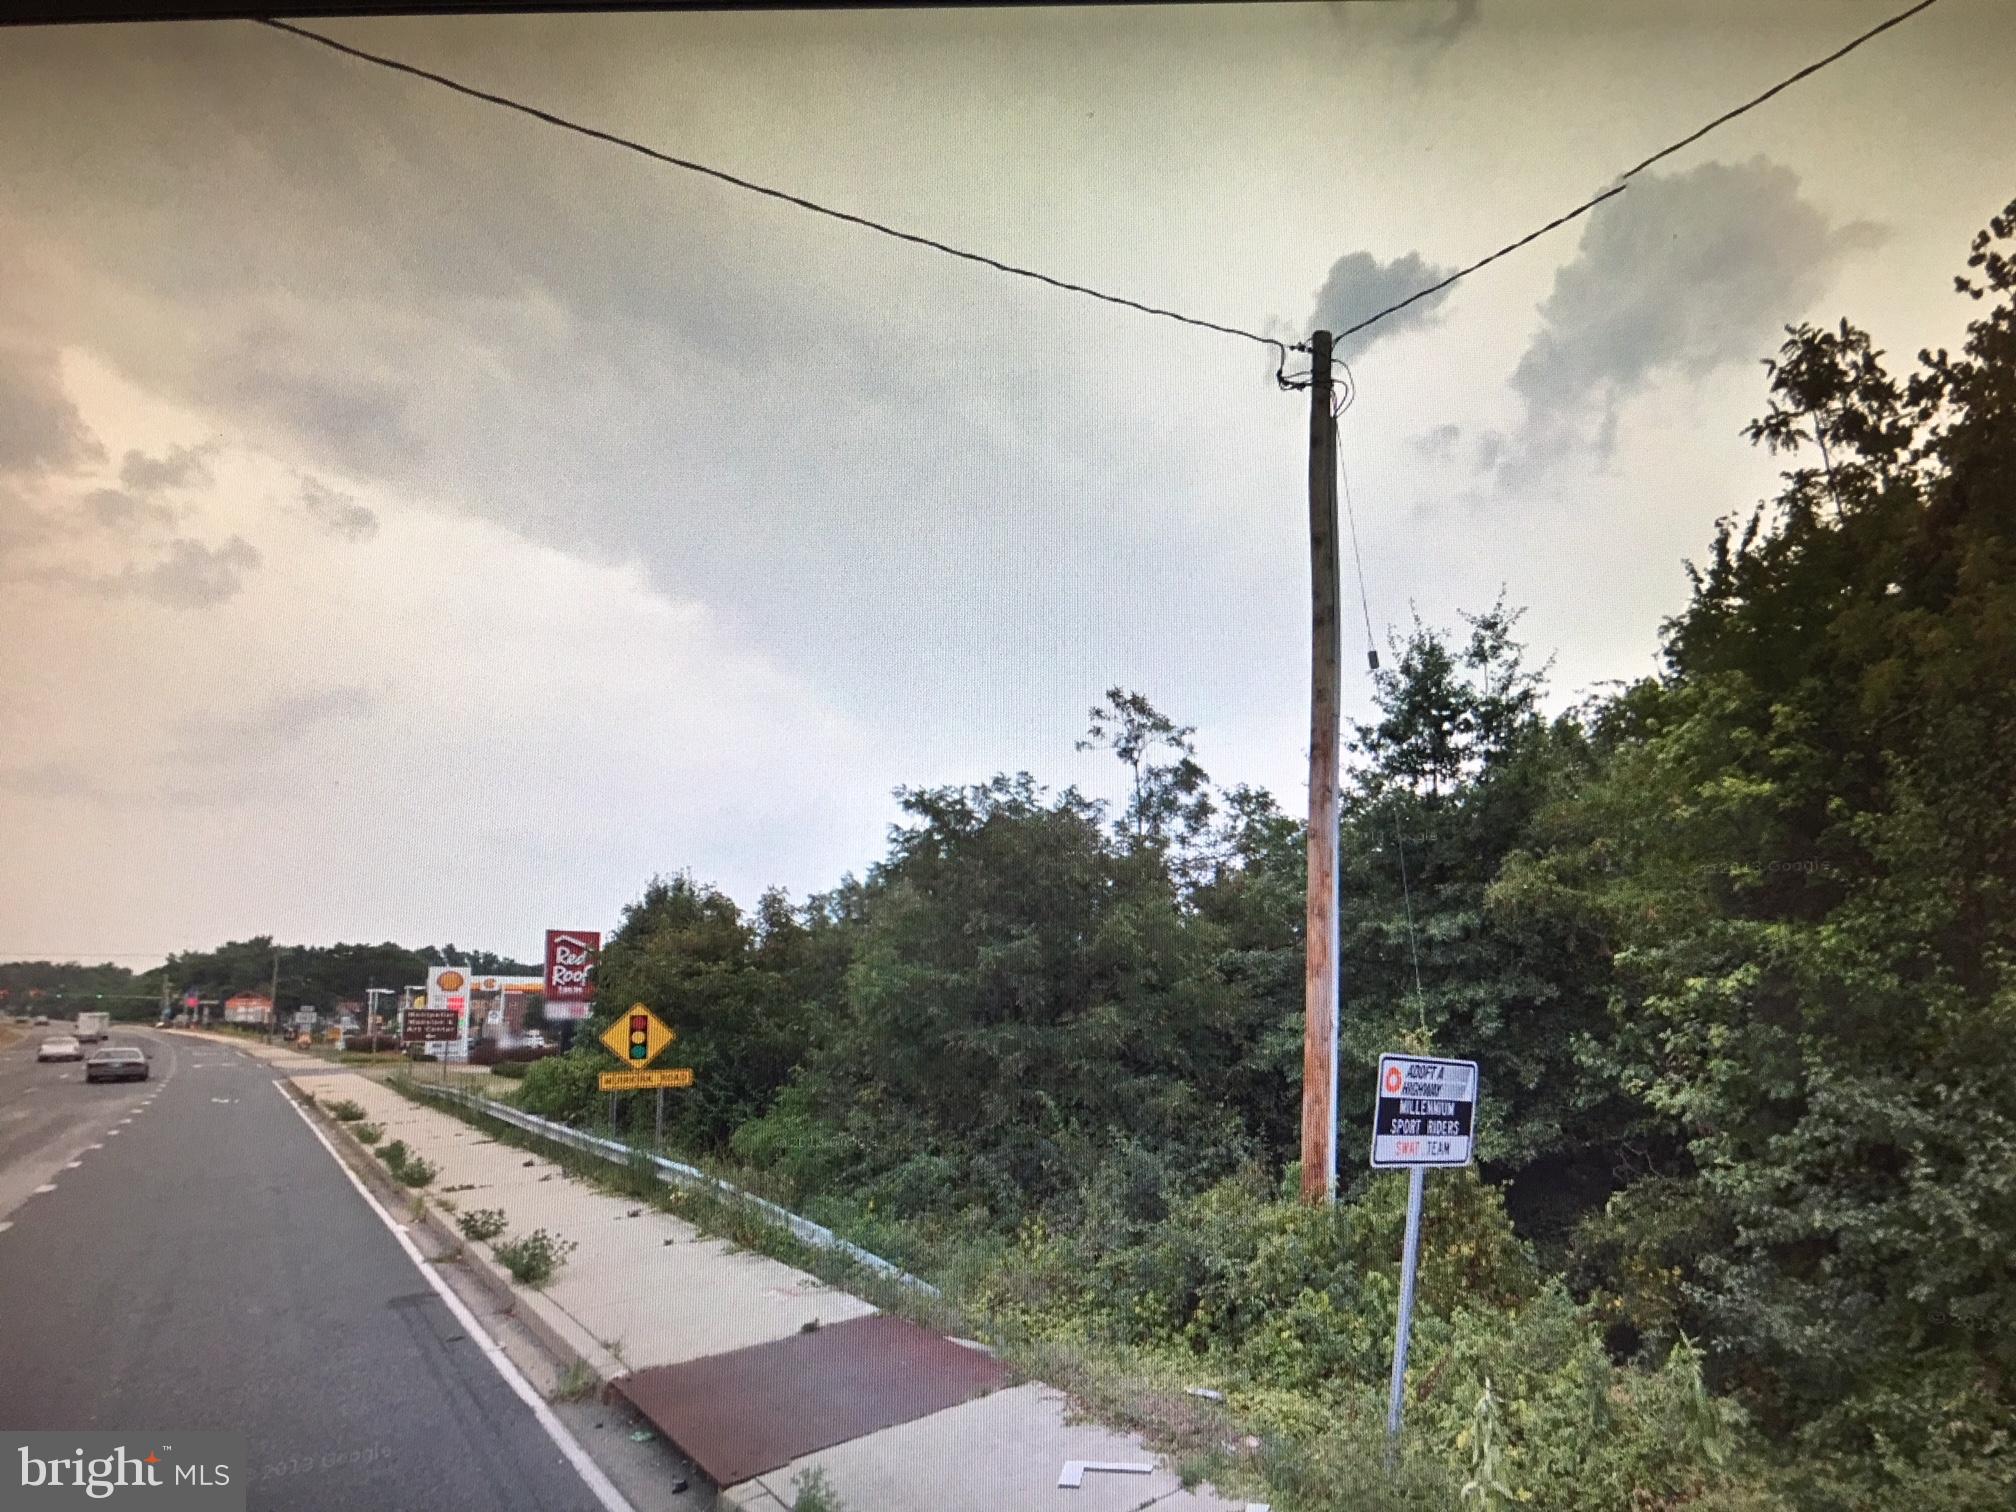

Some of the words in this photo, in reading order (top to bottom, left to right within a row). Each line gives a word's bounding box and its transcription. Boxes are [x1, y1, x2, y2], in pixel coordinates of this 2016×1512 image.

[556, 946, 588, 965] Red
[552, 964, 594, 987] Roof
[1407, 1065, 1437, 1079] ADOPT
[1438, 1067, 1444, 1080] A
[1390, 1119, 1421, 1134] SPORT
[1427, 1120, 1459, 1135] RIDERS
[1396, 1141, 1420, 1155] SWAT
[1427, 1141, 1450, 1155] TEAM
